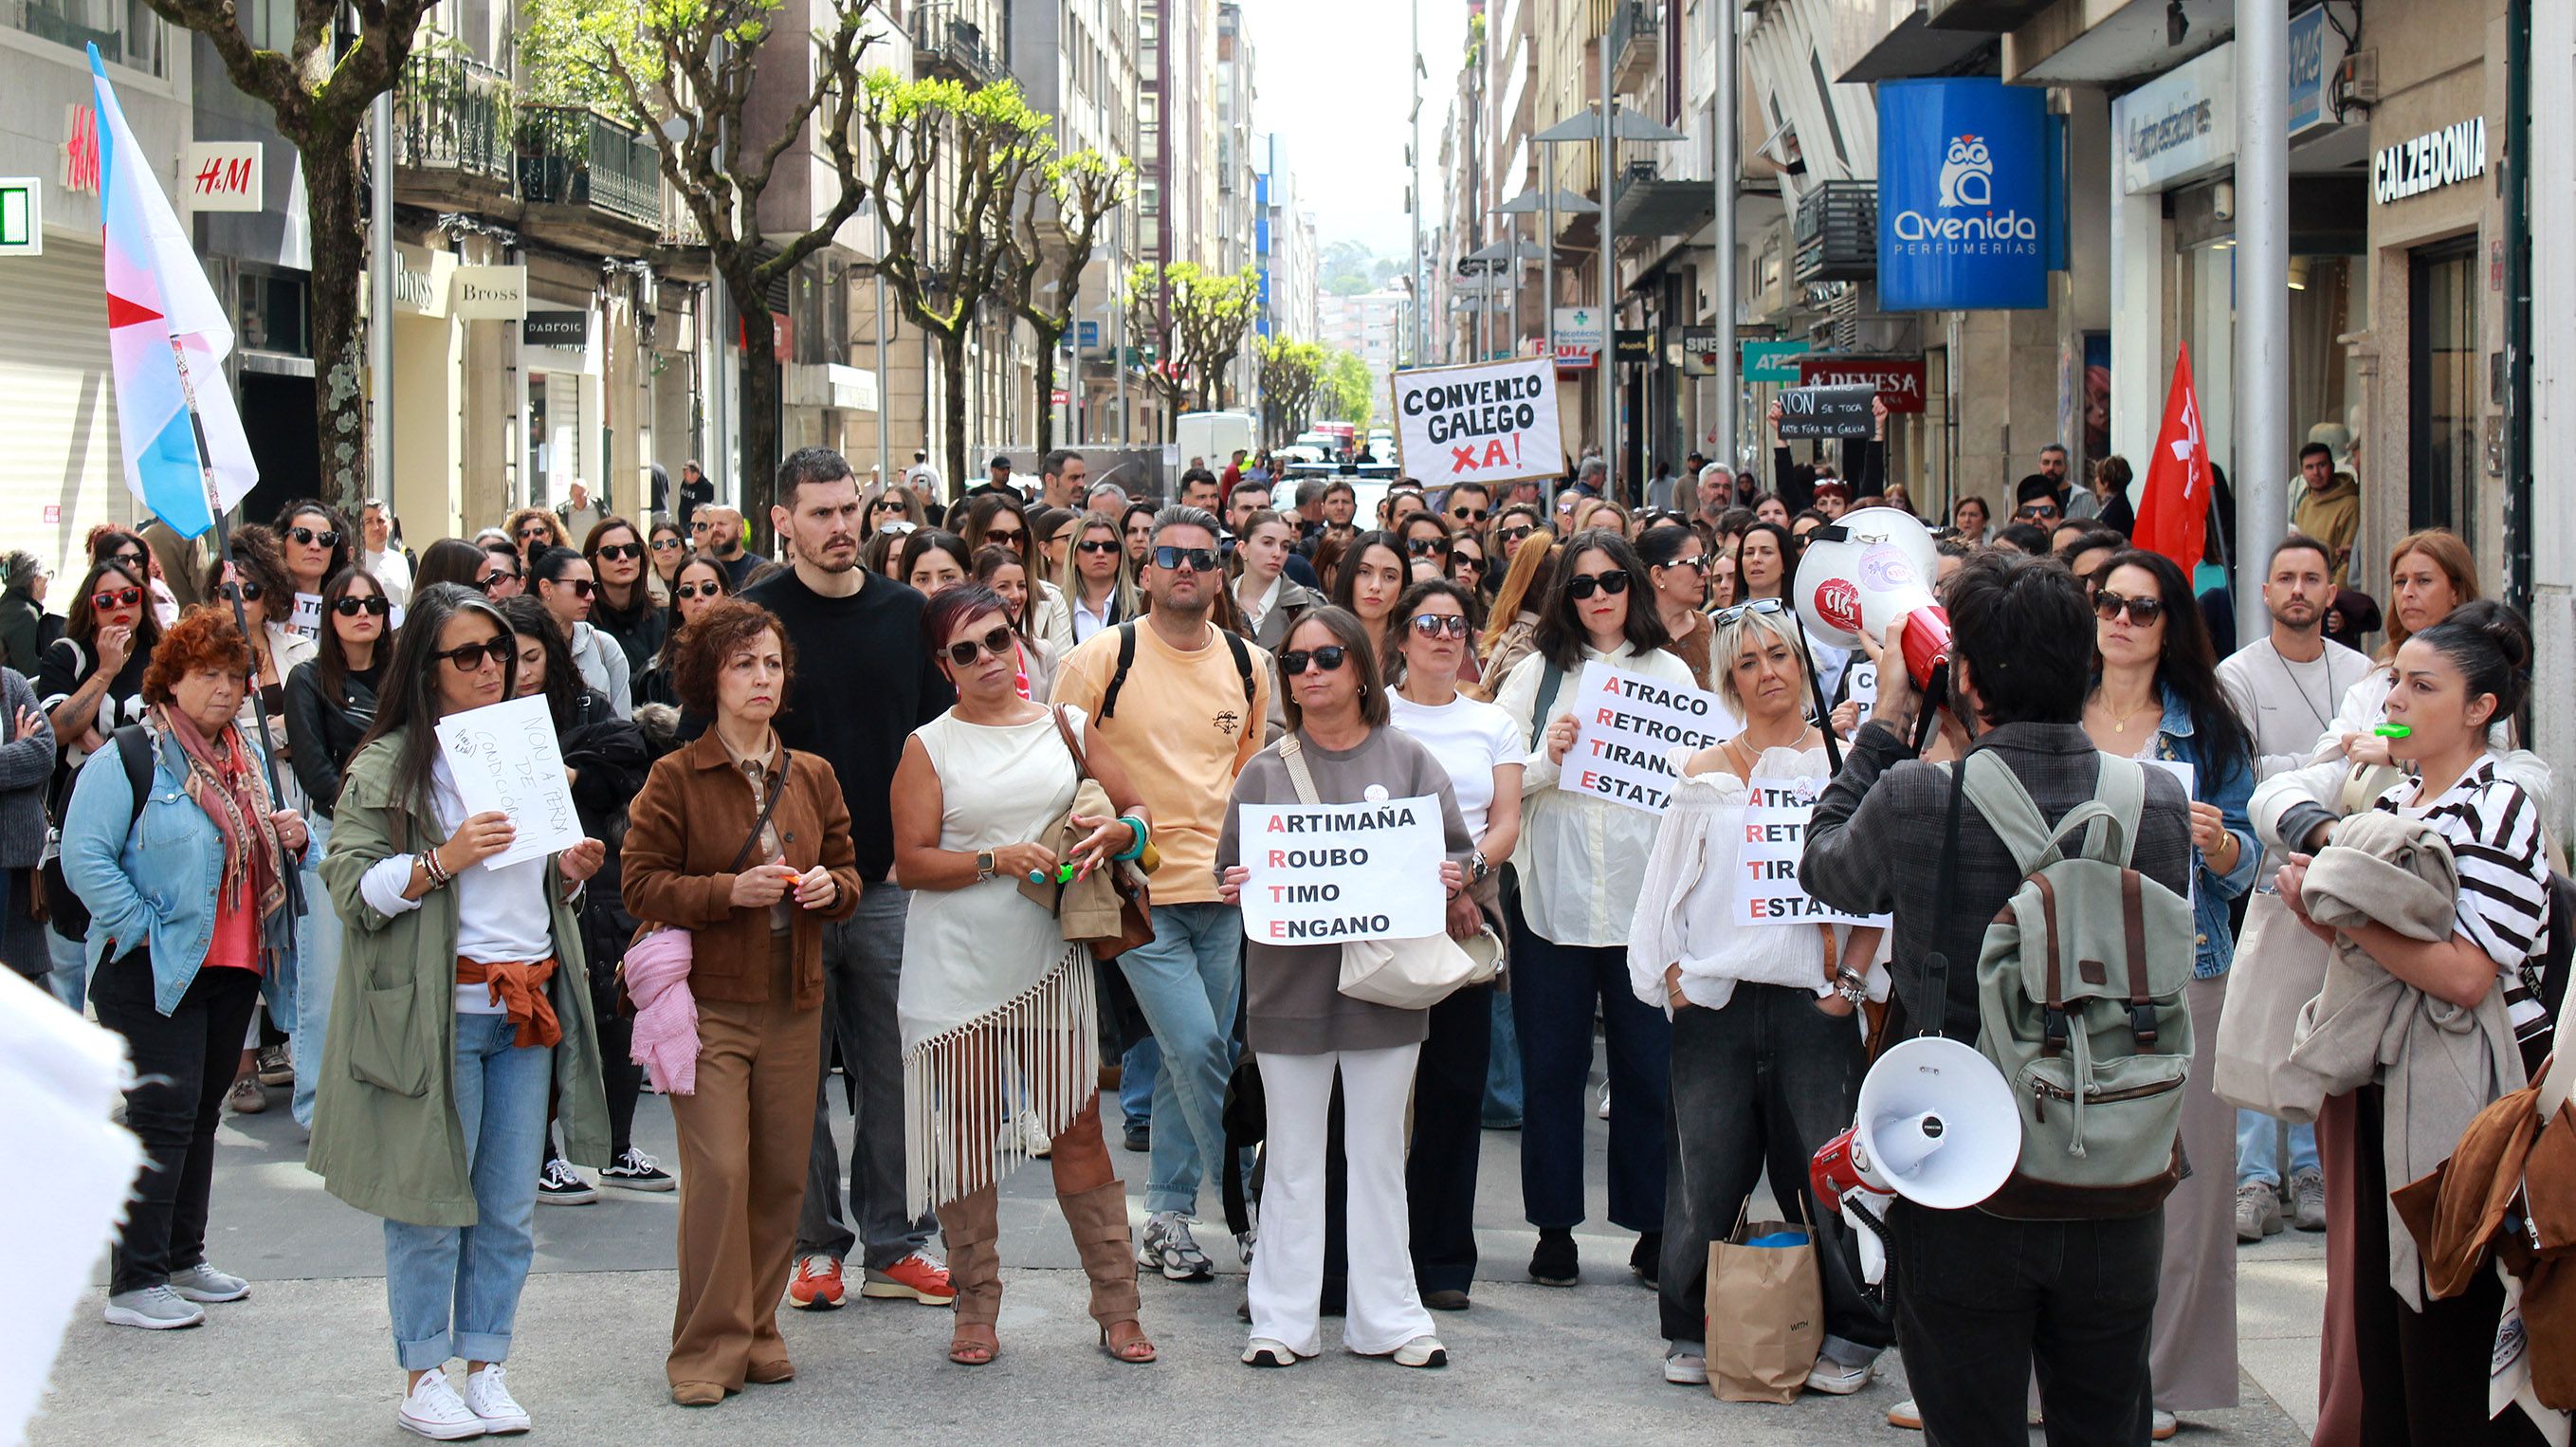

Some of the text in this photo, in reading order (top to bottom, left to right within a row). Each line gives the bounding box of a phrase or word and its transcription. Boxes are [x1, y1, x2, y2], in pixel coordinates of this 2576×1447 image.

[2374, 116, 2486, 205] CALZEDONIA
[195, 157, 253, 195] H&M
[1894, 210, 2037, 241] avenida
[1894, 240, 2037, 255] PERFUMERÍAS
[394, 251, 433, 308] Bross
[462, 284, 518, 302] Bross
[1404, 375, 1543, 415] CONVENIO
[1779, 393, 1862, 415] NON SE TOCA
[1429, 403, 1534, 444] GALEGO
[1781, 426, 1799, 434] ARTE
[1823, 426, 1833, 434] DE
[1452, 432, 1523, 474] XA!
[1602, 676, 1708, 716] ATRACO
[521, 716, 552, 761] NON
[515, 755, 538, 789] DE
[1580, 770, 1672, 810] ESTATA
[1267, 805, 1416, 833] ARTIMAÑA
[1746, 824, 1809, 843] RET
[1269, 848, 1368, 869] ROUBO
[1746, 860, 1799, 881] TIR
[1268, 884, 1340, 903] TIMO
[1750, 897, 1870, 919] ESTA
[1270, 914, 1390, 938] ENGANO
